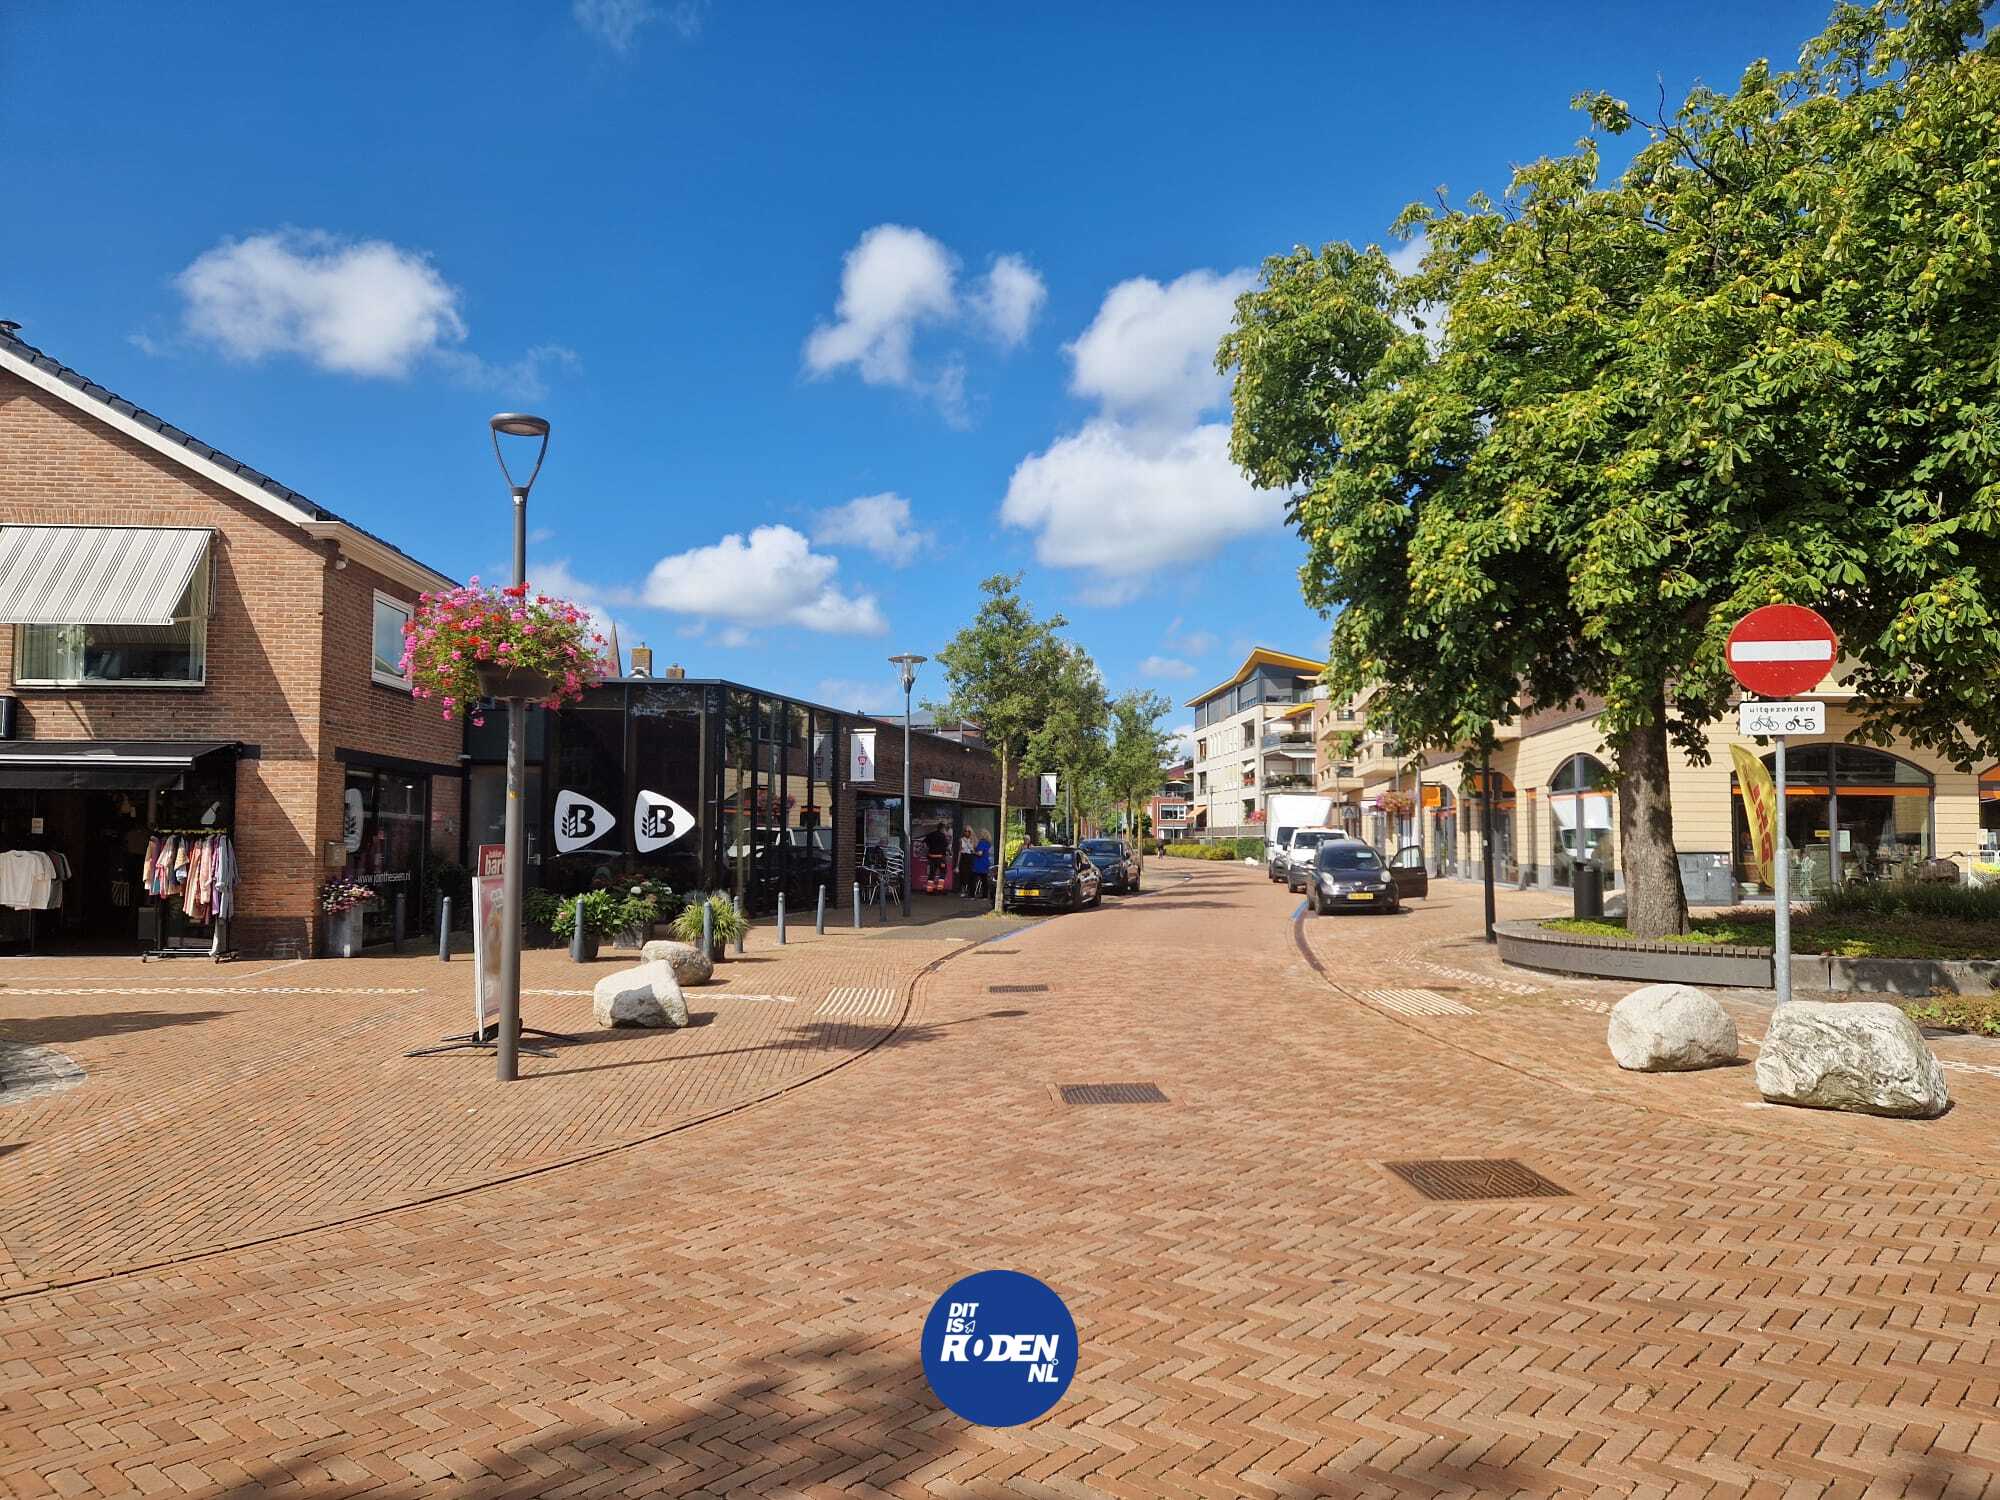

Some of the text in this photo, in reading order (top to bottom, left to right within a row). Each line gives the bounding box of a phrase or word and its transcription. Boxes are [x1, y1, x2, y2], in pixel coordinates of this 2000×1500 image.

[1749, 706, 1816, 714] uitgezonderd
[567, 804, 596, 838] B
[648, 804, 676, 838] B
